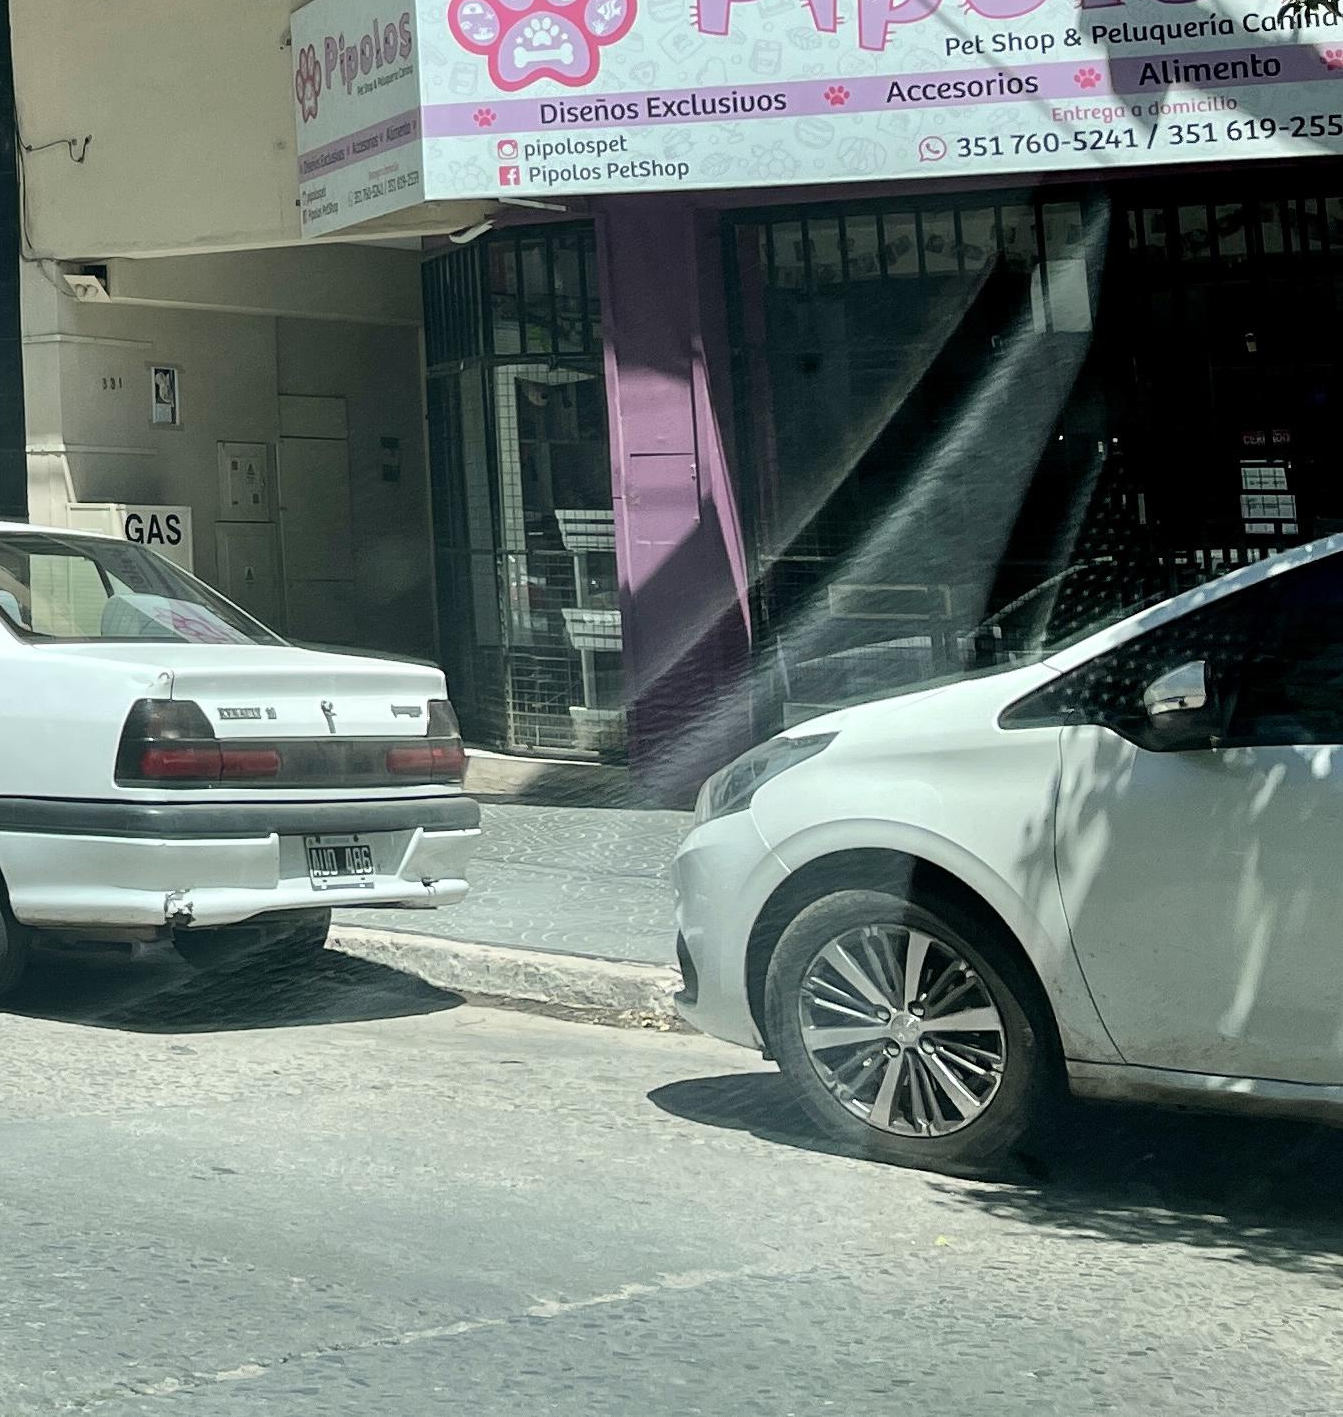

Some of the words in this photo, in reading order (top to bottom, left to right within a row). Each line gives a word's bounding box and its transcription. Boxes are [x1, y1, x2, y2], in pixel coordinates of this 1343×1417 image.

[946, 34, 984, 56] Pet
[992, 31, 1055, 55] Shop
[1064, 27, 1082, 46] &
[1092, 12, 1233, 47] Peluquería
[324, 12, 412, 95] Pipolos
[1139, 53, 1281, 86] Alimento
[886, 72, 1039, 103] Accesorios
[540, 99, 639, 124] Diseños
[647, 90, 787, 119] Exclusivos
[1052, 103, 1125, 124] Entrega
[1131, 104, 1142, 116] a
[1148, 95, 1237, 117] domicilio
[524, 135, 628, 161] pipolospet
[957, 136, 1004, 158] 351
[1012, 127, 1139, 154] 760-5241
[1146, 124, 1158, 150] /
[1168, 122, 1217, 146] 351
[529, 162, 602, 186] Pipolos
[607, 158, 690, 181] PetShop
[125, 513, 182, 545] GAS
[345, 847, 373, 875] 486
